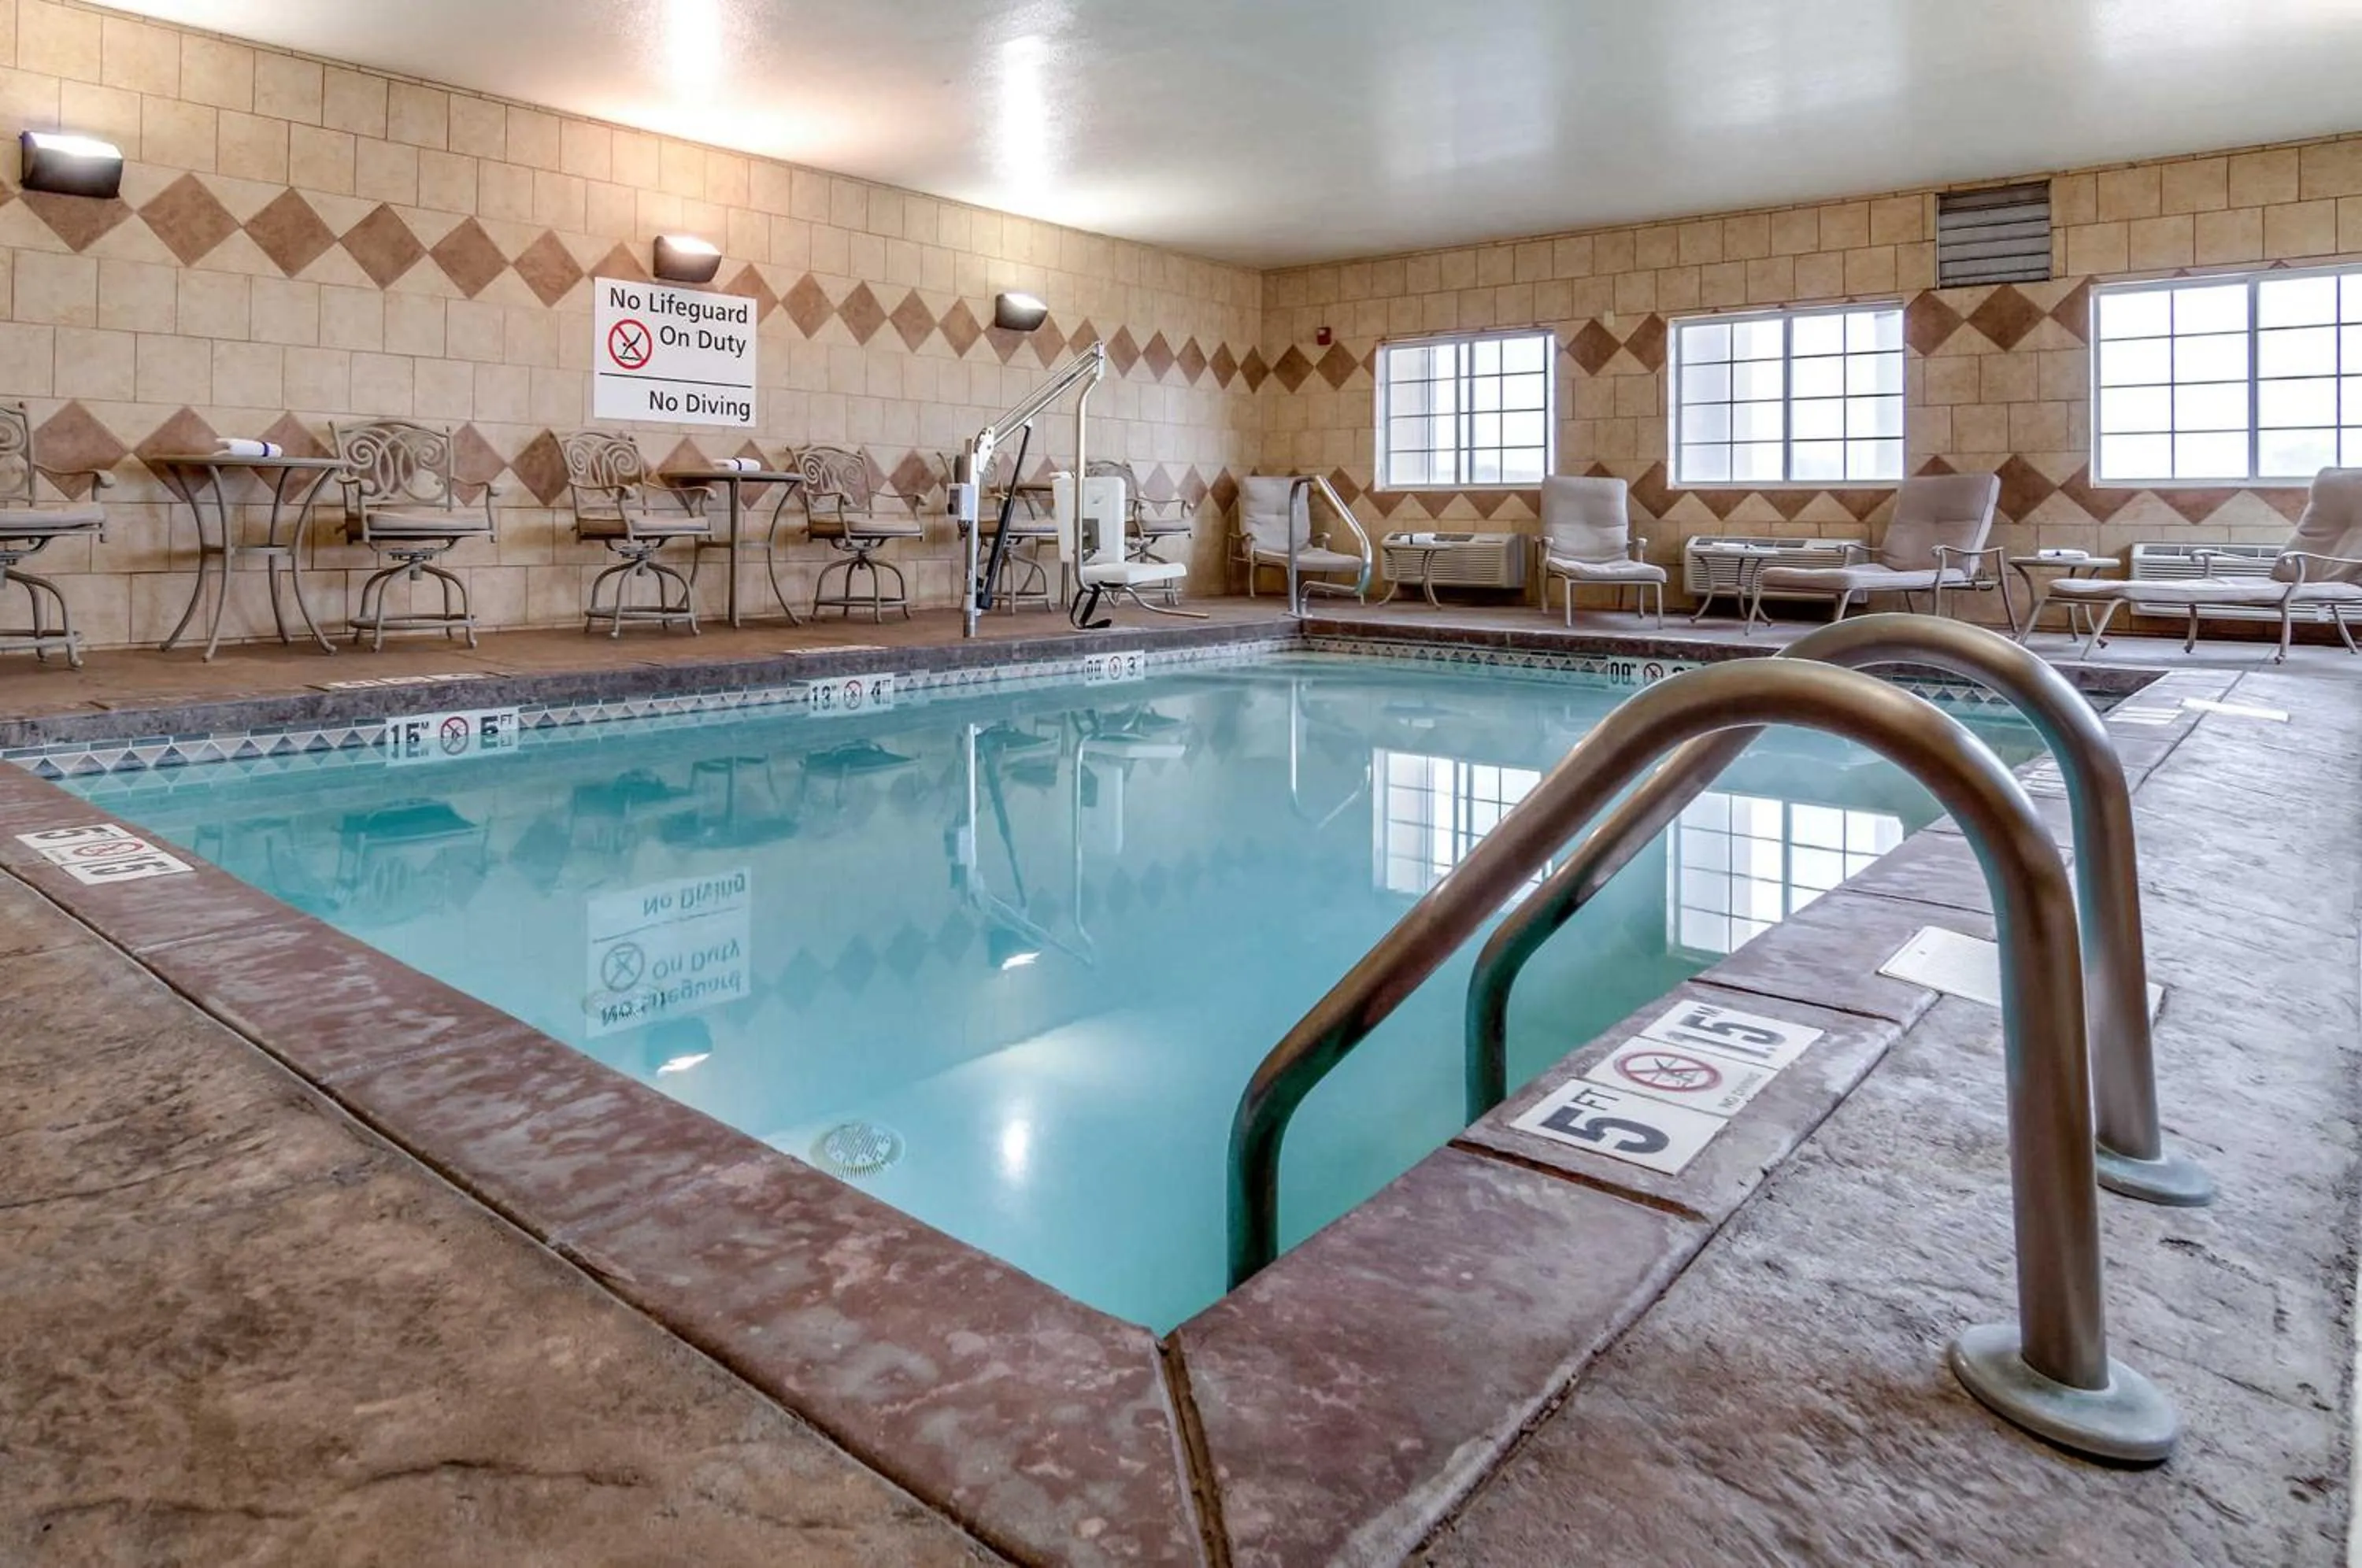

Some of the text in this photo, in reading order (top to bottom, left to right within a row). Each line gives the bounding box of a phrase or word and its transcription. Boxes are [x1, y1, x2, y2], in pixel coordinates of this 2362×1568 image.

[610, 287, 747, 324] No Lifeguard
[660, 325, 746, 357] On Duty
[650, 390, 750, 422] No Diving
[1539, 1088, 1671, 1155] 5 FT
